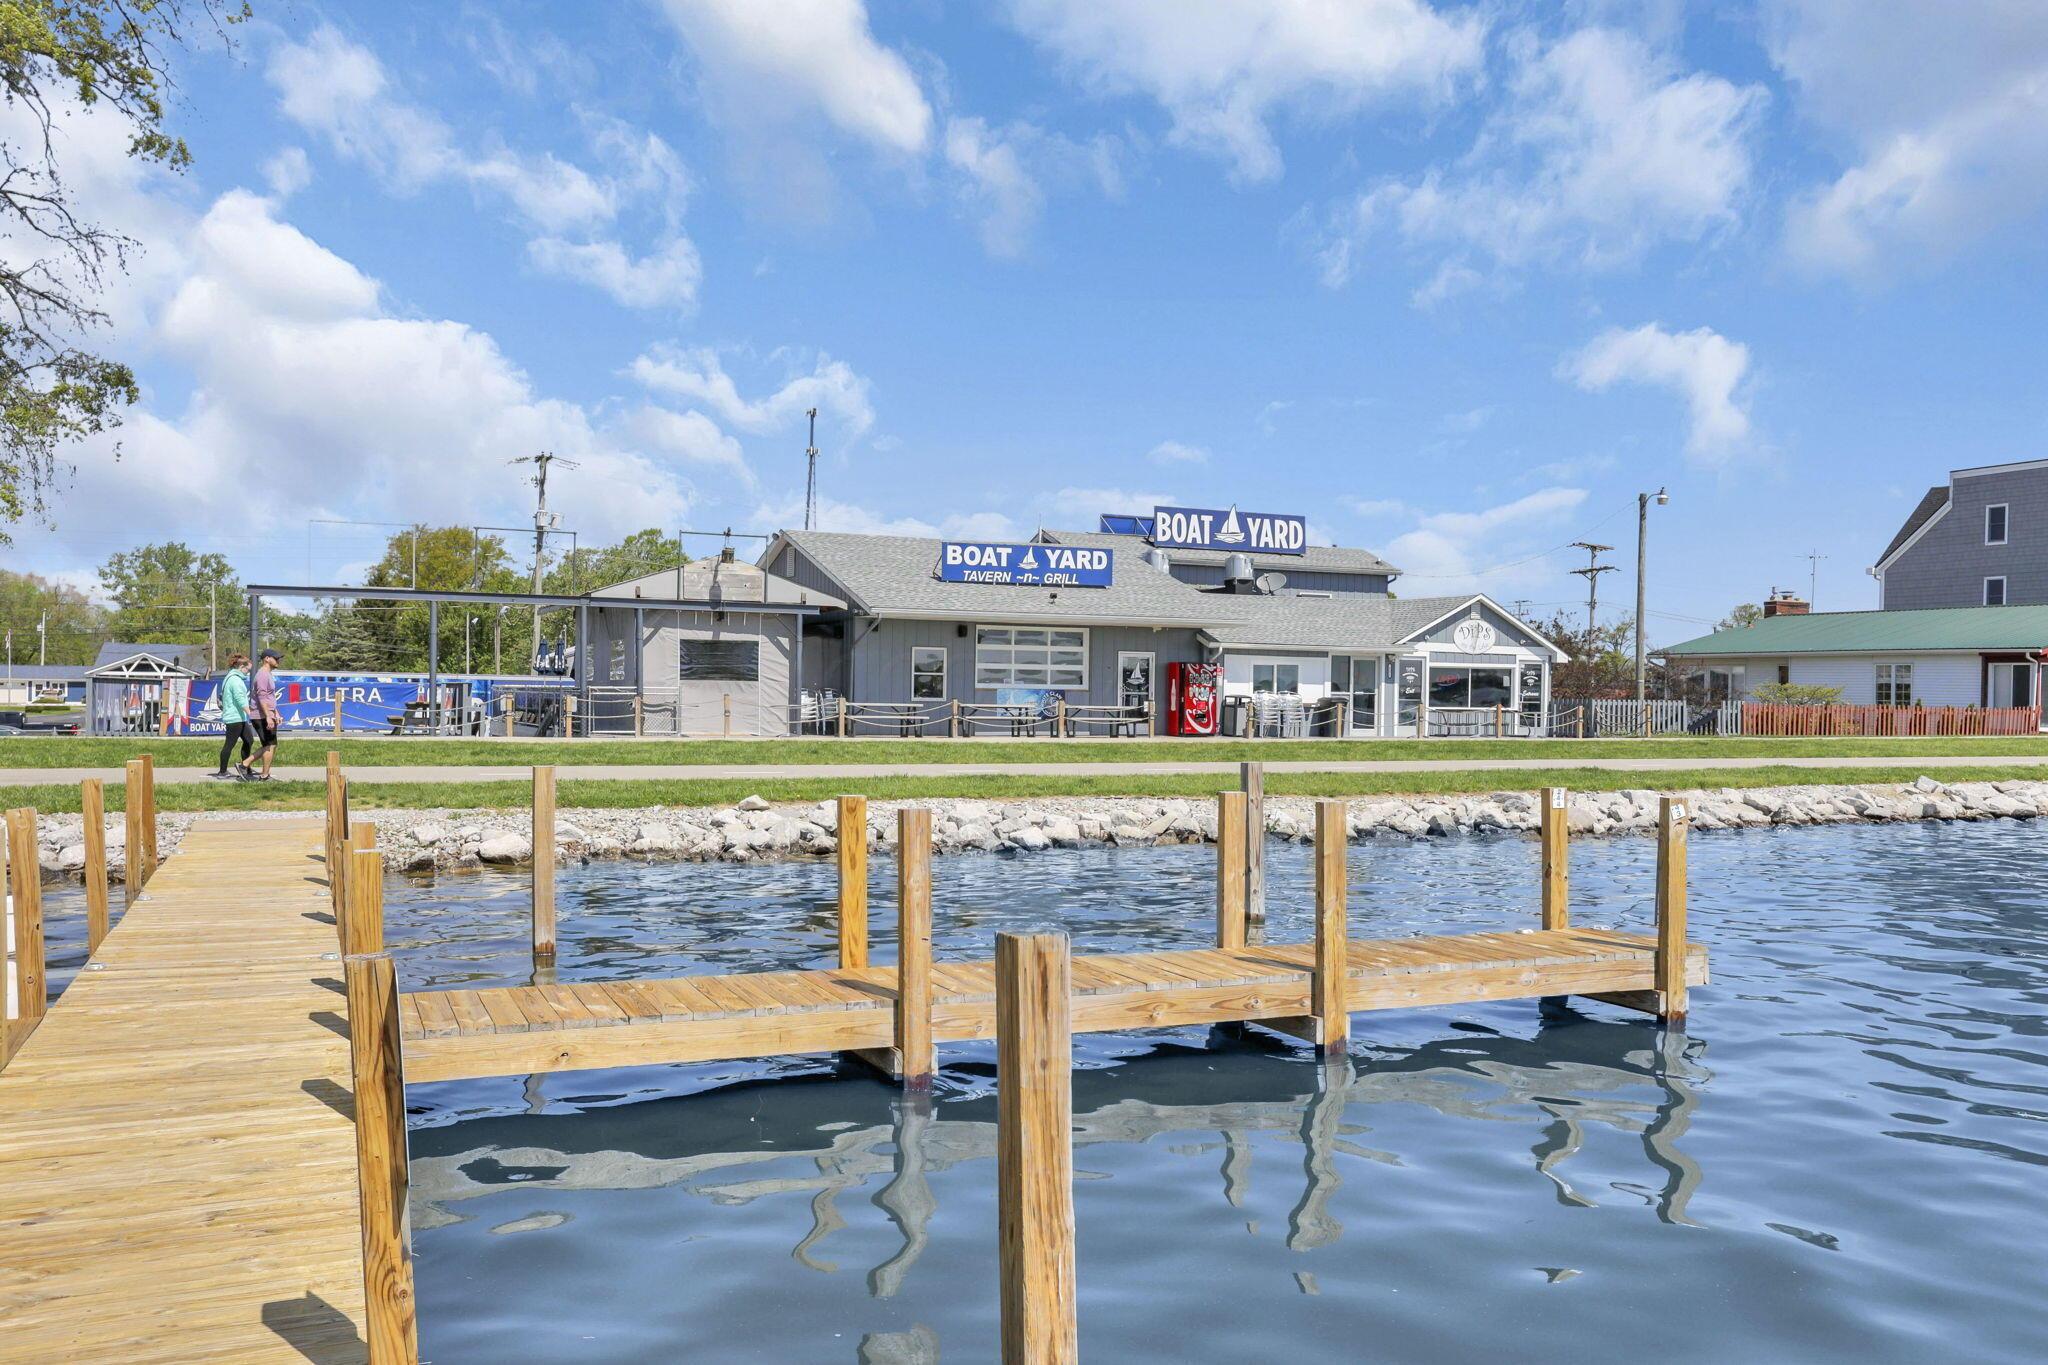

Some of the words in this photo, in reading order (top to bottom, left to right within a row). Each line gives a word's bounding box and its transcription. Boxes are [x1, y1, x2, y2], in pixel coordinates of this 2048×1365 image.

[1156, 511, 1213, 544] BOAT
[1246, 517, 1304, 549] YARD
[946, 545, 1012, 567] BOAT
[1045, 549, 1108, 570] YARD
[963, 570, 1011, 583] TAVERN
[1044, 573, 1079, 585] GRILL
[306, 686, 383, 703] ULTRA
[189, 723, 209, 732] BOAT
[210, 723, 227, 732] YAR
